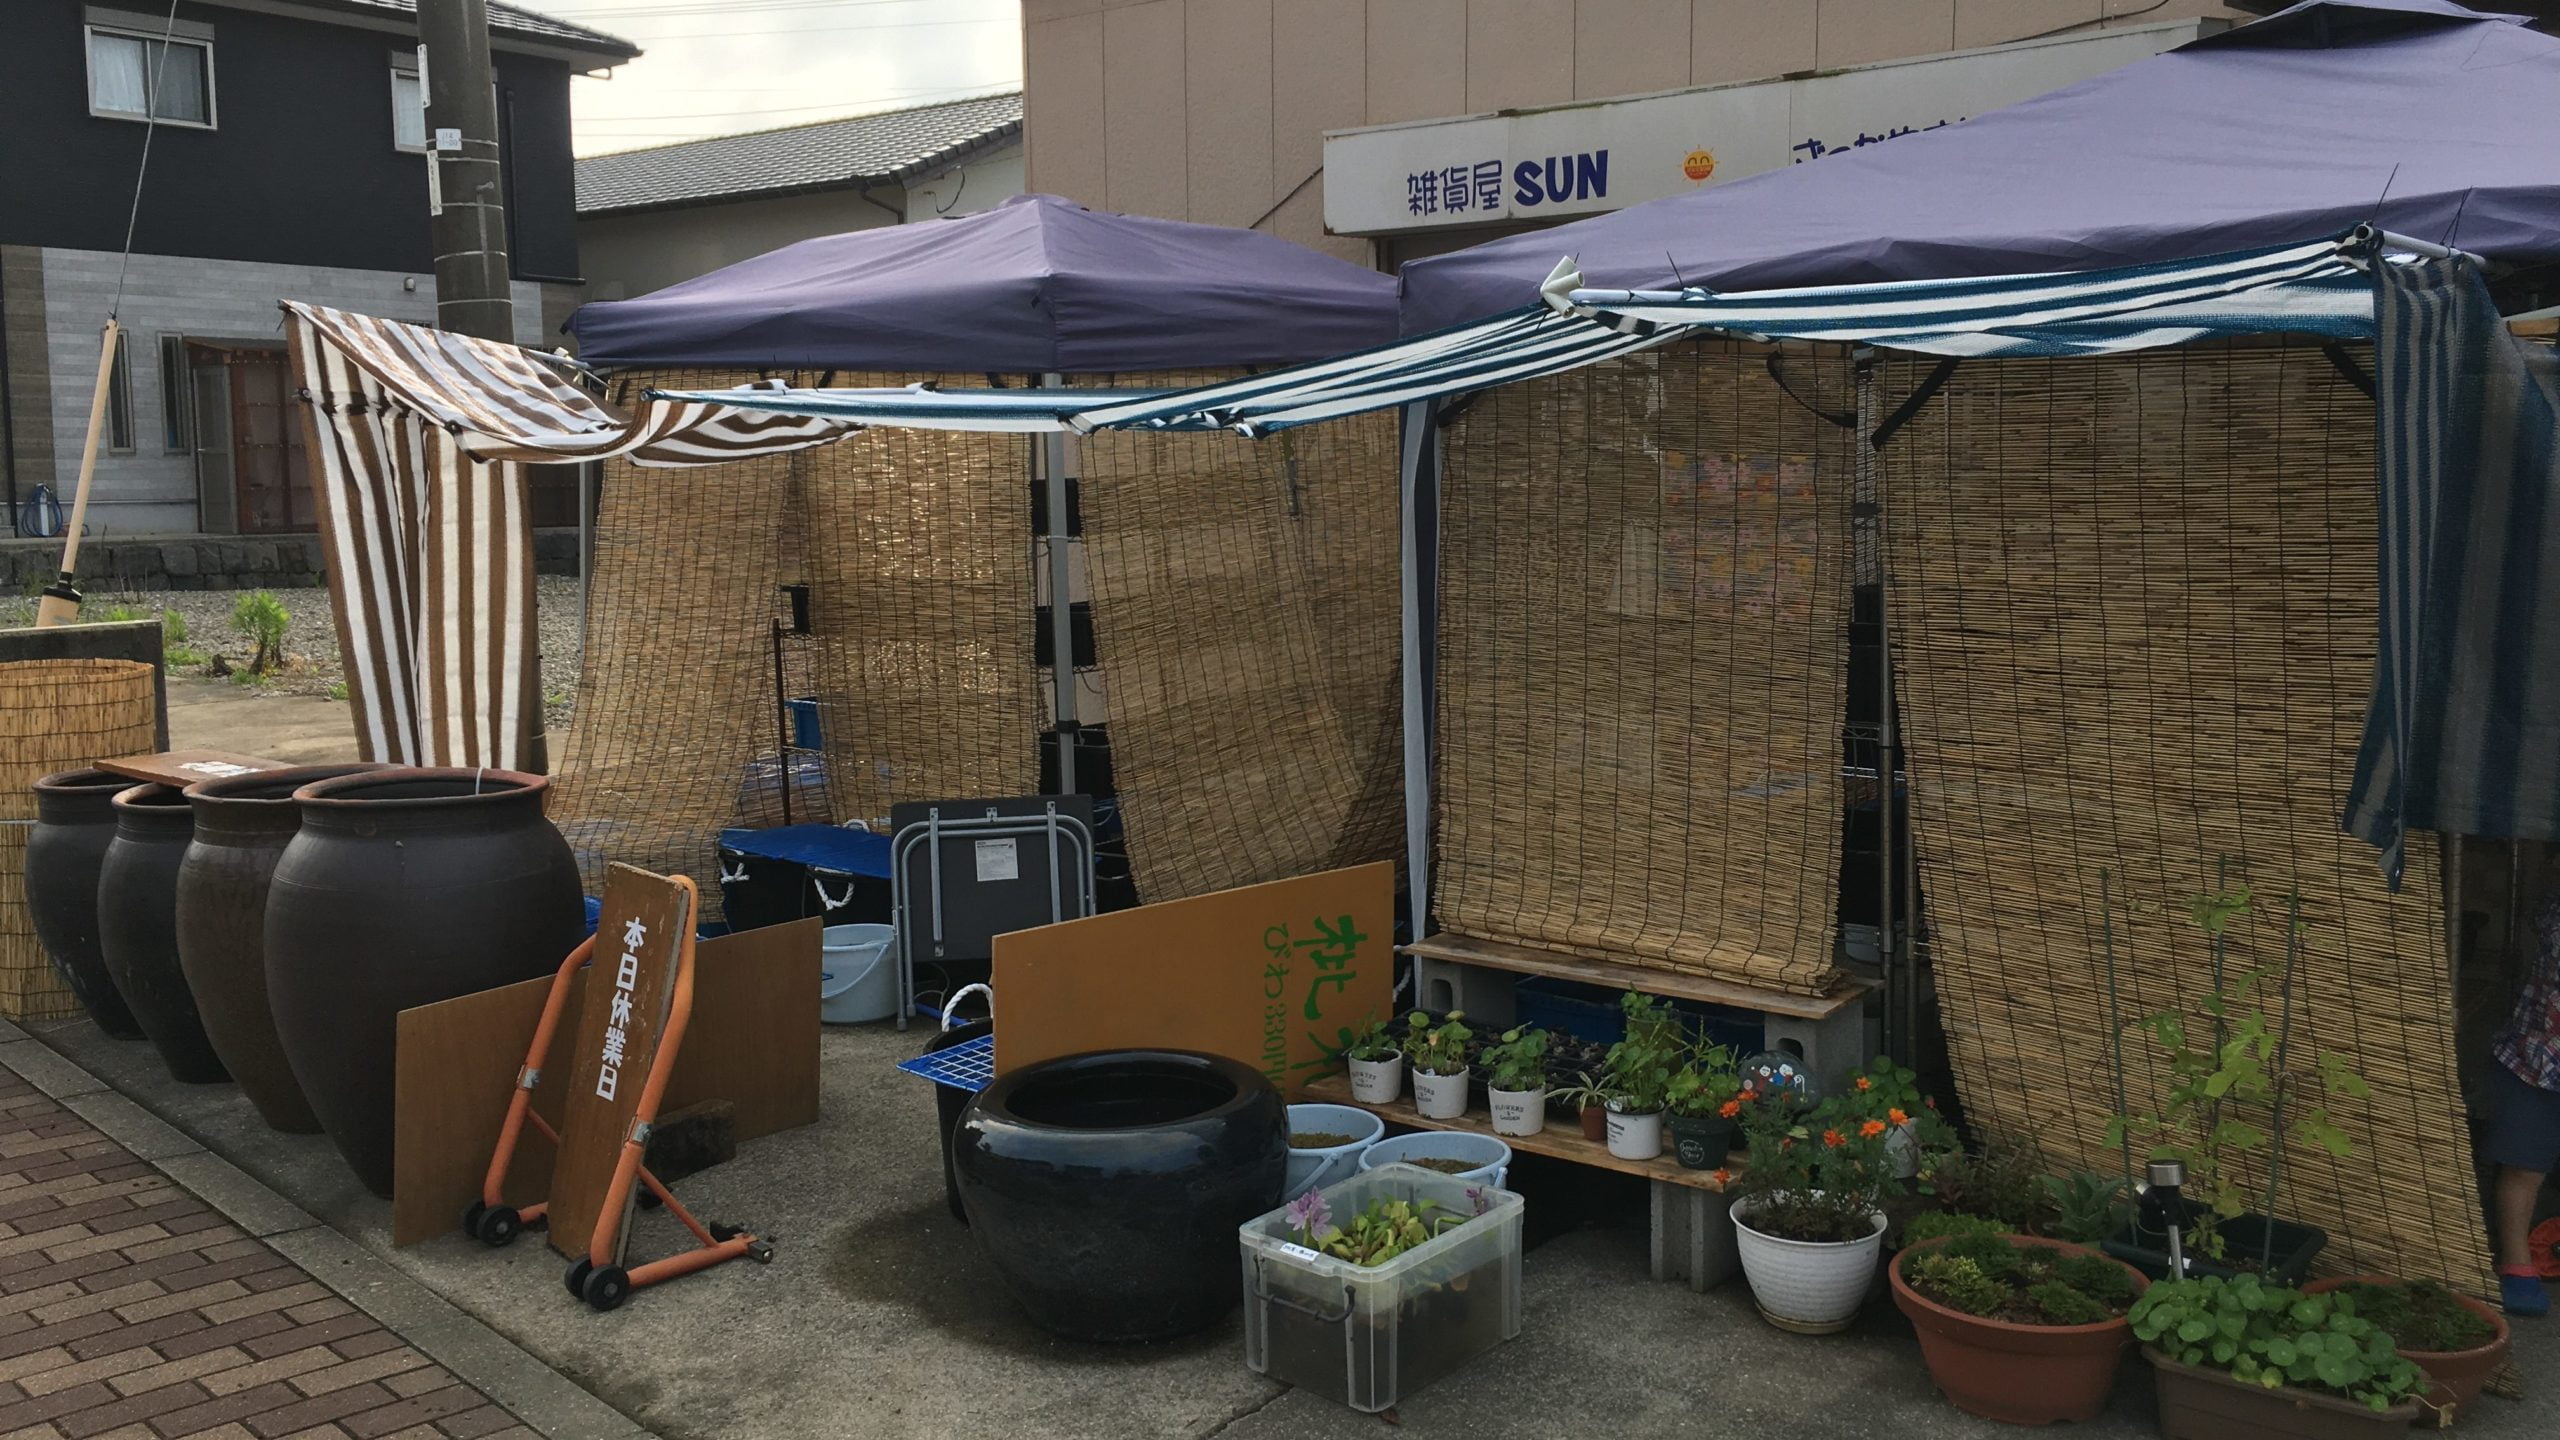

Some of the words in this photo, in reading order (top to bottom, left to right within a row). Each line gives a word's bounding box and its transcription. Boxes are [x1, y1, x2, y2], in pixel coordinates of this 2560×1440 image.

[1407, 160, 1502, 216] 雑貨屋
[1514, 150, 1608, 206] SUN
[596, 916, 647, 1102] 本日休業日
